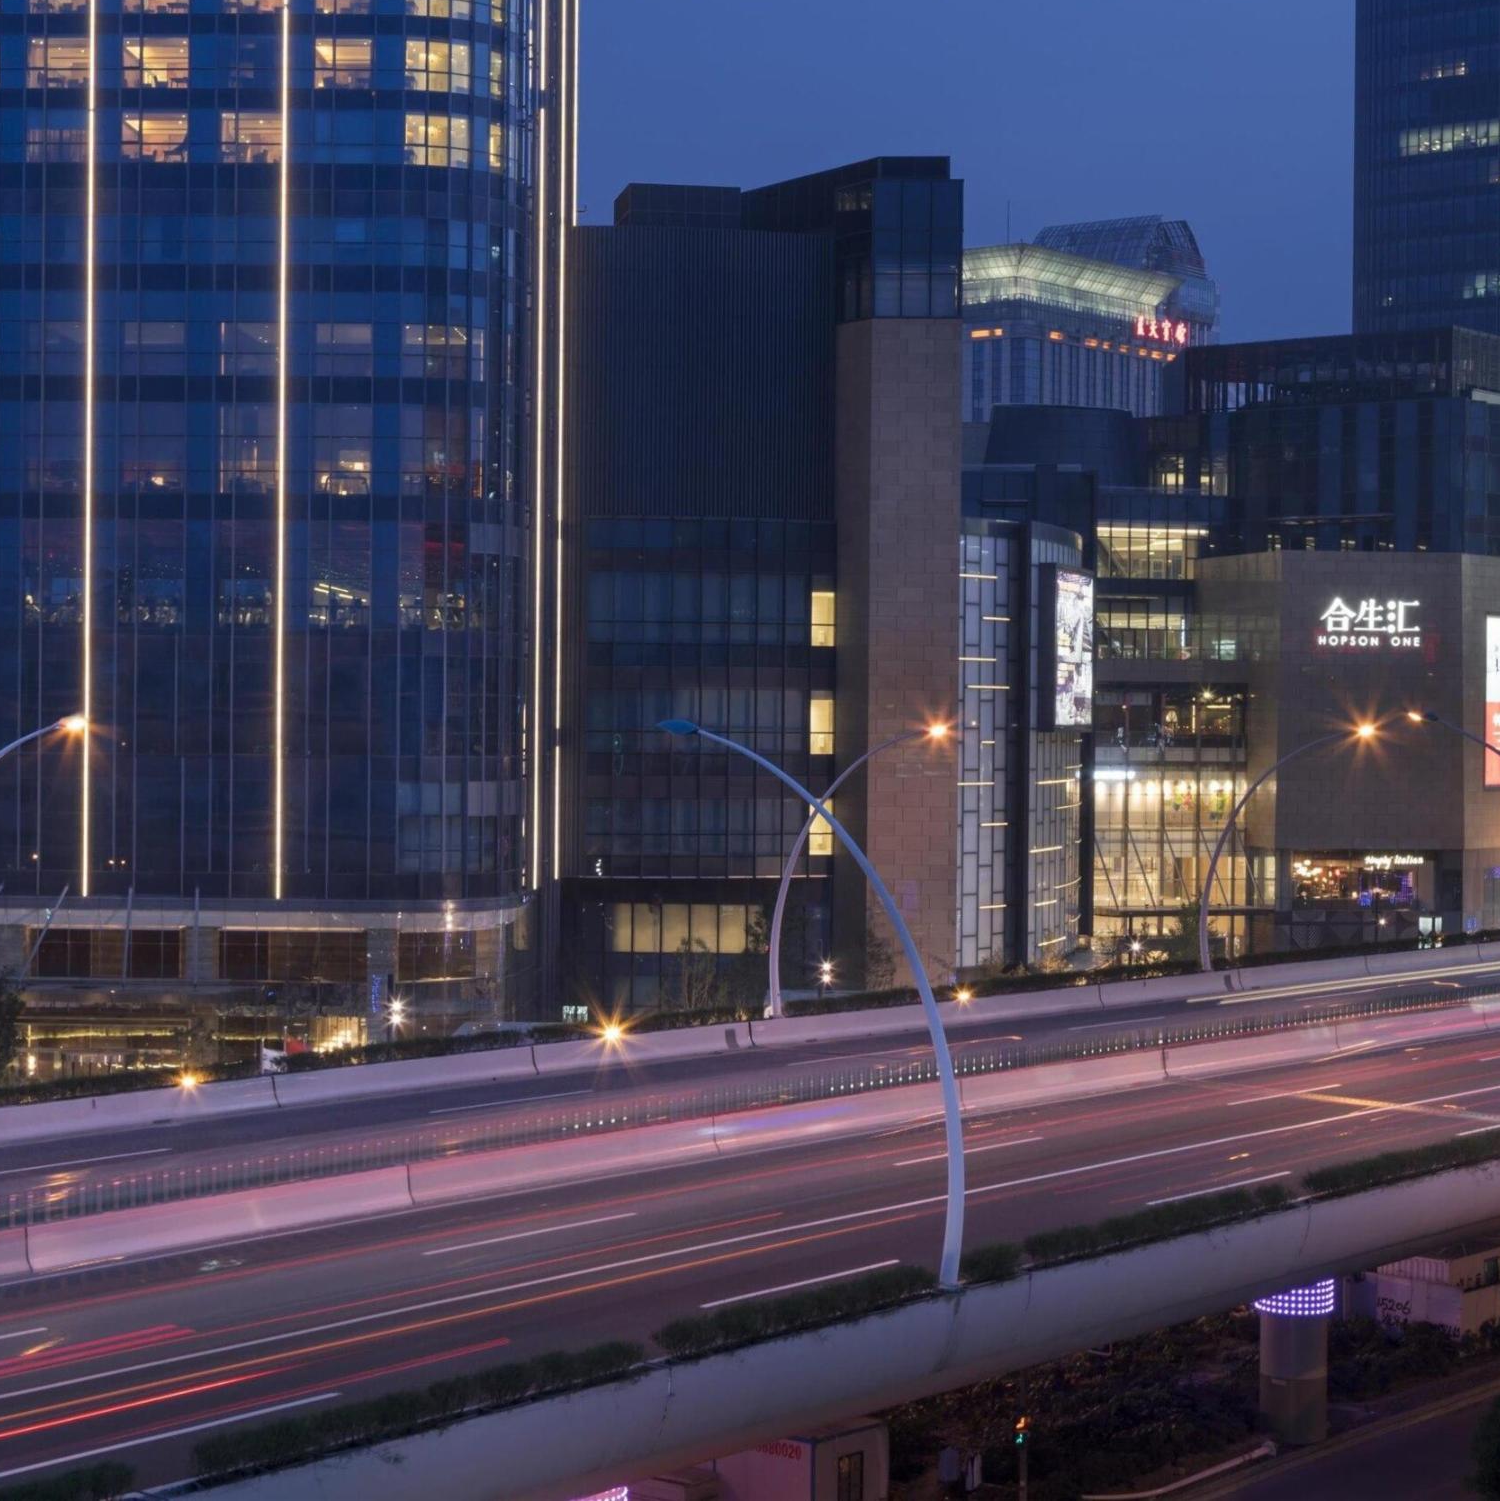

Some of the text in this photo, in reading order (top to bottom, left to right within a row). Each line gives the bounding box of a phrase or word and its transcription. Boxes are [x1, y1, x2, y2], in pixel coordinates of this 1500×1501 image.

[1319, 596, 1421, 634] 合生汇
[1317, 635, 1421, 647] HOPSON ONE
